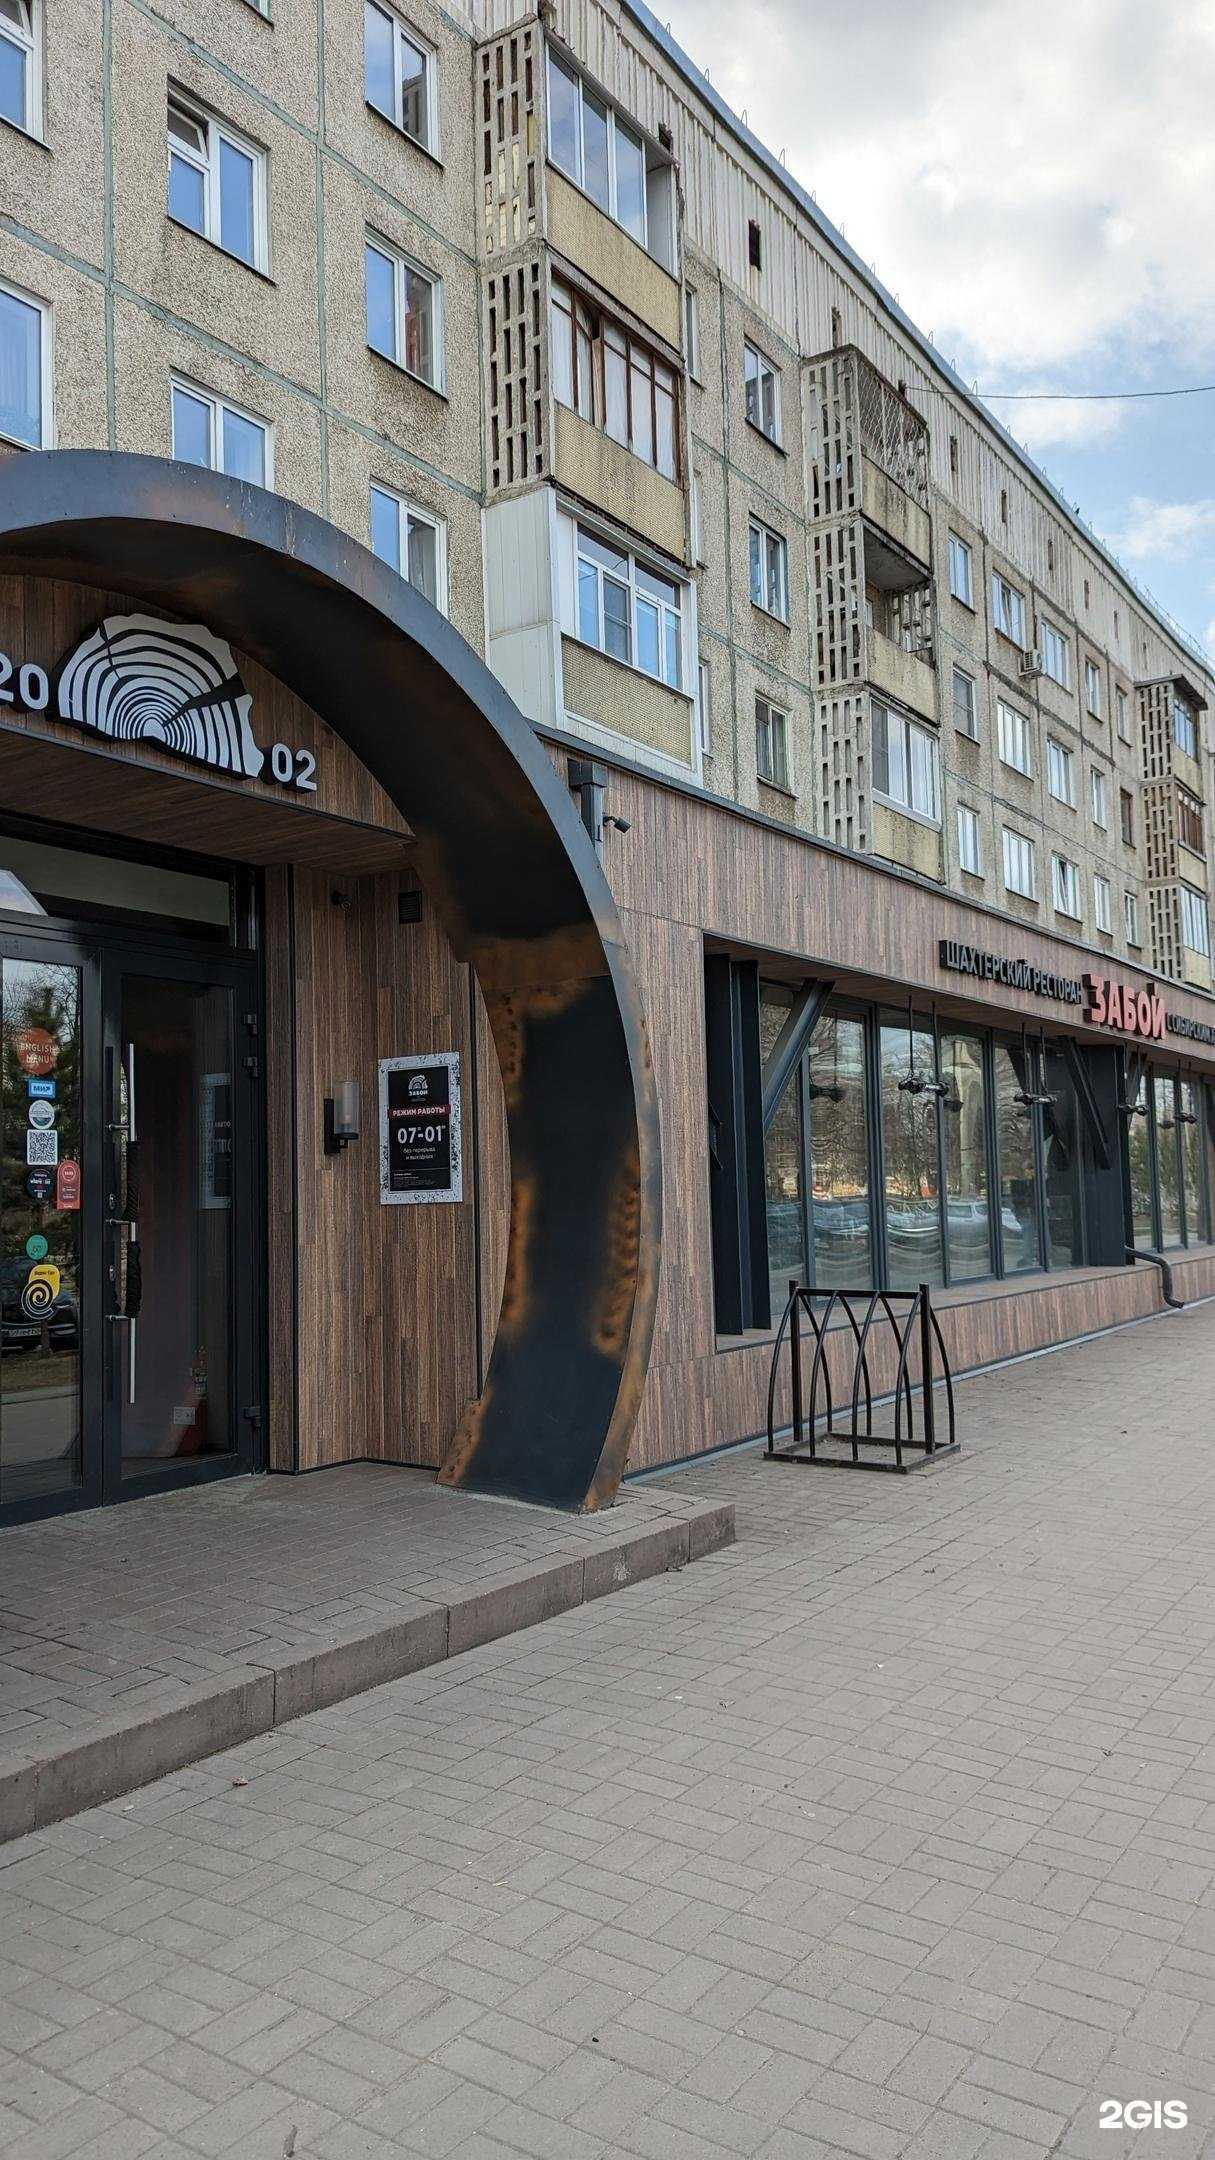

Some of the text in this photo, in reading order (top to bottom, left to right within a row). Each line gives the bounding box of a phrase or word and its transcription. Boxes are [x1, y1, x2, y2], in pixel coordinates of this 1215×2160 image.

[271, 742, 318, 791] 02
[943, 939, 1032, 991] ШАХТЕРСКИЙ
[1033, 967, 1082, 1005] РЕСТОРАН
[1087, 973, 1167, 1040] ЗАБОЙ
[20, 1042, 55, 1053] ENGLISH
[392, 1106, 446, 1117] РЕЖИМ РАБОТЫ
